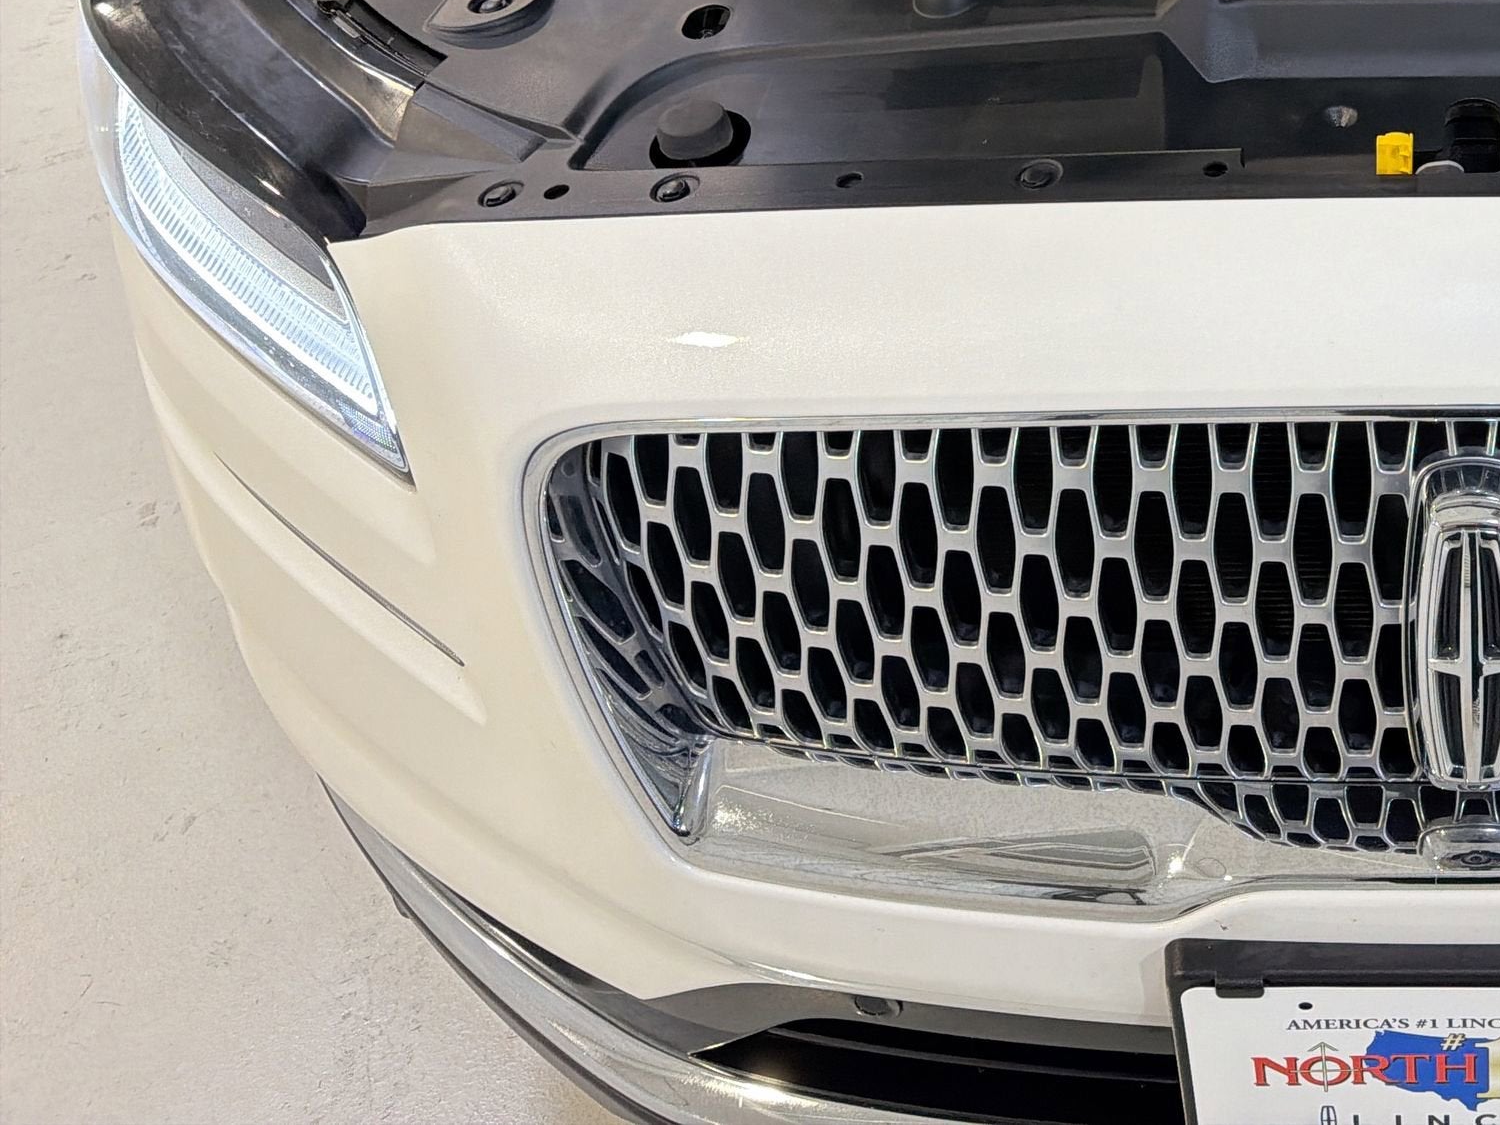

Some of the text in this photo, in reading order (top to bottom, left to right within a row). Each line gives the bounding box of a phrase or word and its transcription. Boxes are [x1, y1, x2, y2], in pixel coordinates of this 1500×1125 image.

[1286, 1018, 1410, 1030] AMERICA'S
[1416, 1018, 1439, 1029] #1
[1252, 1053, 1480, 1085] NORTH
